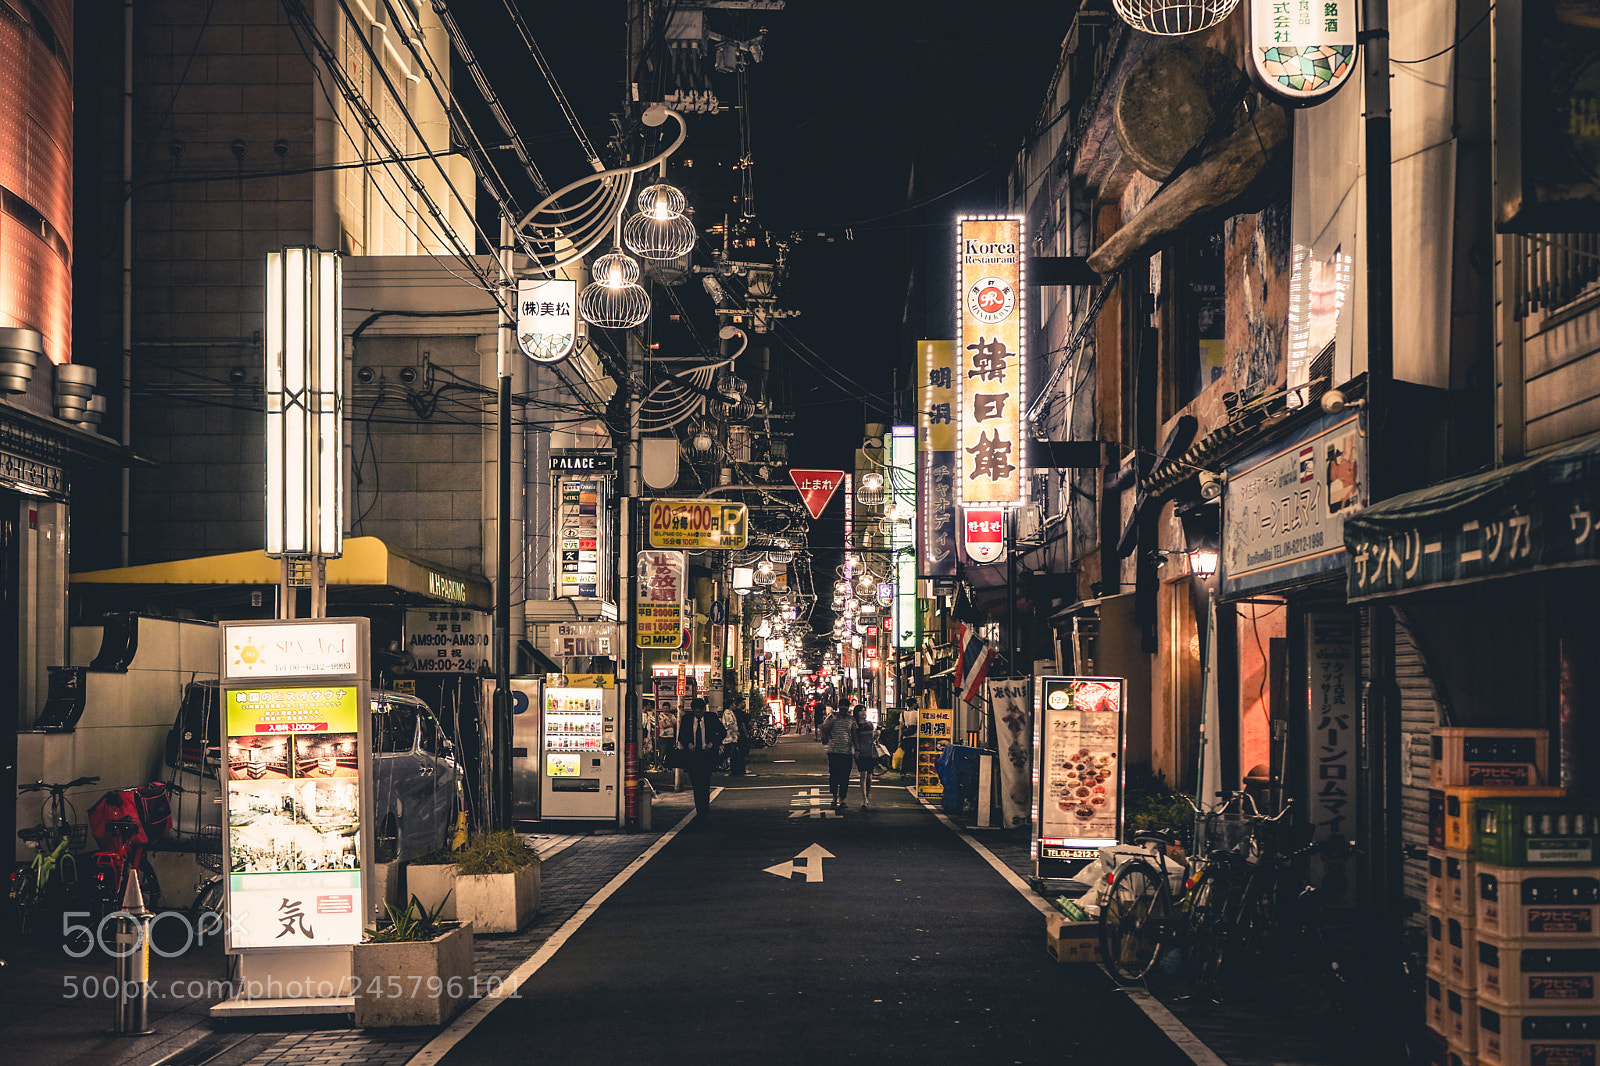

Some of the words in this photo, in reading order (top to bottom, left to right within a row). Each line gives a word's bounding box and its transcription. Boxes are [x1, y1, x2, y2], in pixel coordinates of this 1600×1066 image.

[965, 239, 1016, 255] Korea
[965, 255, 1016, 264] Restaurant
[552, 457, 595, 469] PALACE
[800, 479, 833, 491] 止まれ
[1461, 505, 1531, 563] ニッカ
[719, 536, 743, 546] MHP
[440, 577, 466, 602] PARKING
[638, 608, 652, 617] 平日
[653, 608, 680, 617] 2000円
[436, 624, 461, 633] 平日
[638, 622, 652, 632] 日祝
[653, 635, 677, 644] MHP
[437, 649, 462, 658] 日祝
[920, 722, 946, 736] 明洞
[1053, 720, 1078, 729] ランチ
[1469, 767, 1528, 779] アサヒビール
[276, 898, 315, 939] 気
[1530, 909, 1591, 922] アサヒビール
[1531, 976, 1592, 989] アサヒビール
